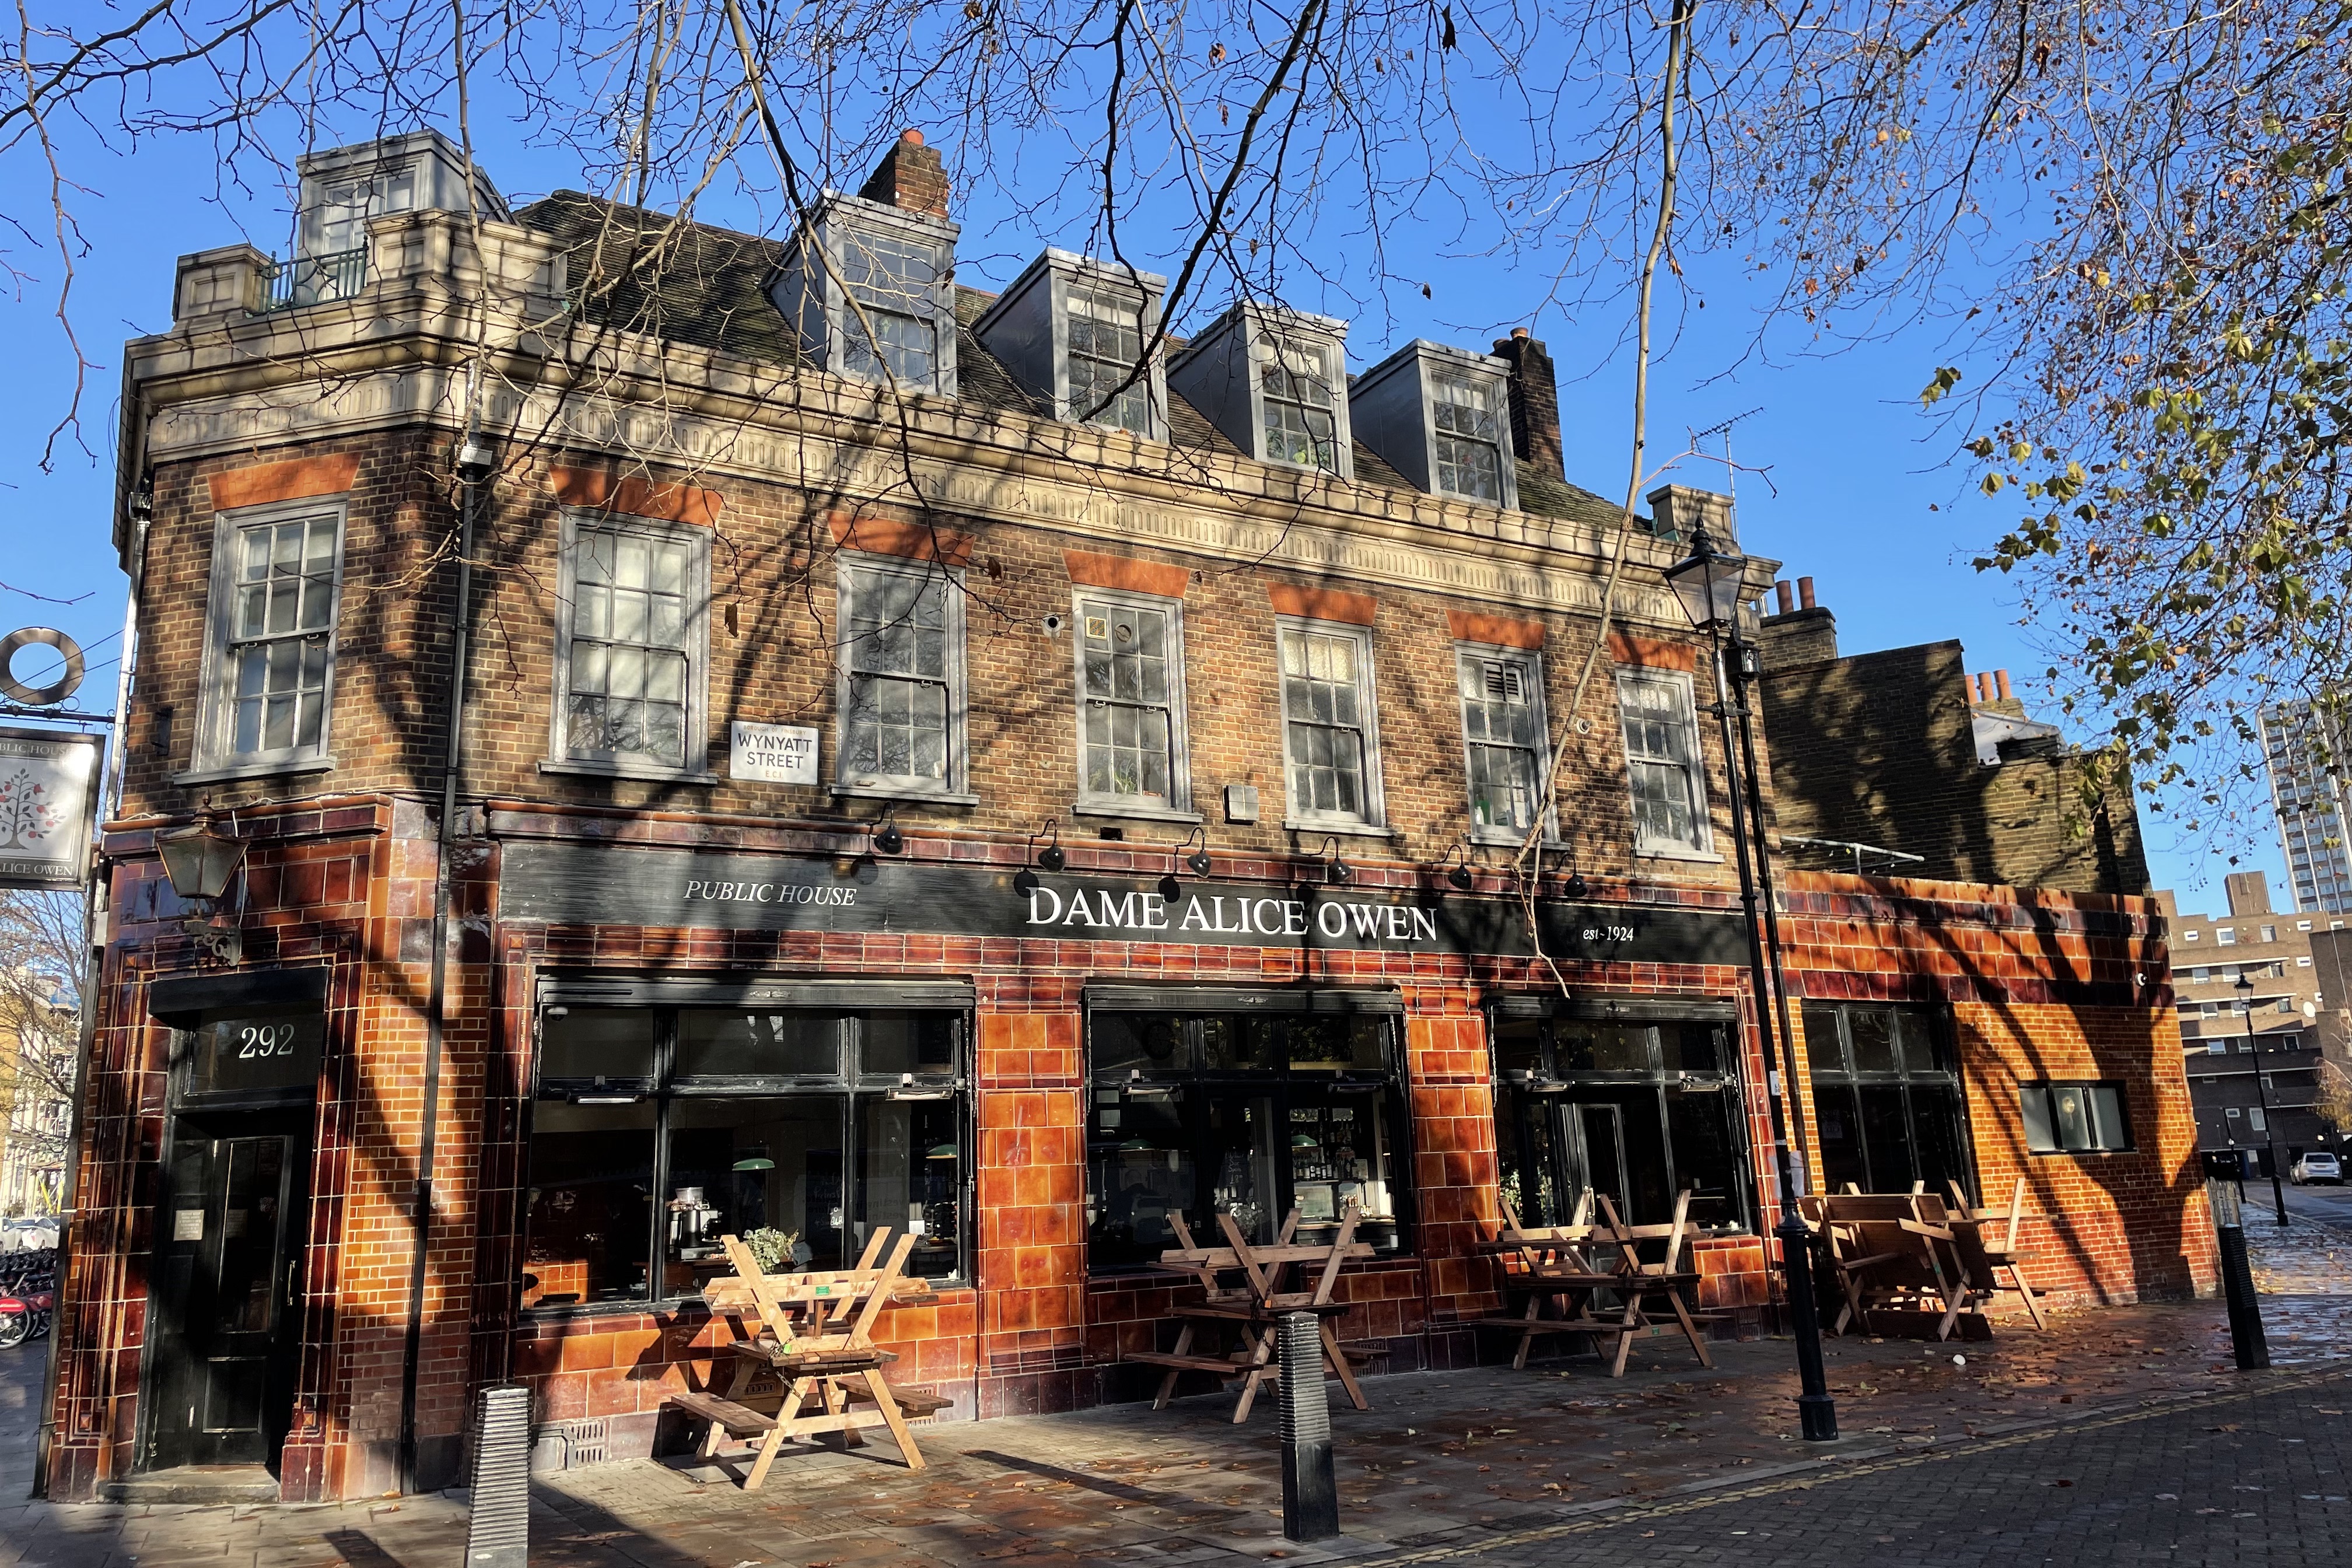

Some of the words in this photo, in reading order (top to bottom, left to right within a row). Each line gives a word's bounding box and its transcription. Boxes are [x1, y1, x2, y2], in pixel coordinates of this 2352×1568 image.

[738, 733, 813, 752] WYNYATT
[747, 751, 804, 769] STREET
[0, 862, 31, 874] LICE
[34, 864, 74, 876] OWEN
[683, 880, 774, 902] PUBLIC
[777, 885, 858, 906] HOUSE
[1026, 886, 1169, 929] DAME
[1178, 894, 1308, 935] ALICE
[1317, 901, 1438, 942] OWEN
[239, 1023, 295, 1059] 292
